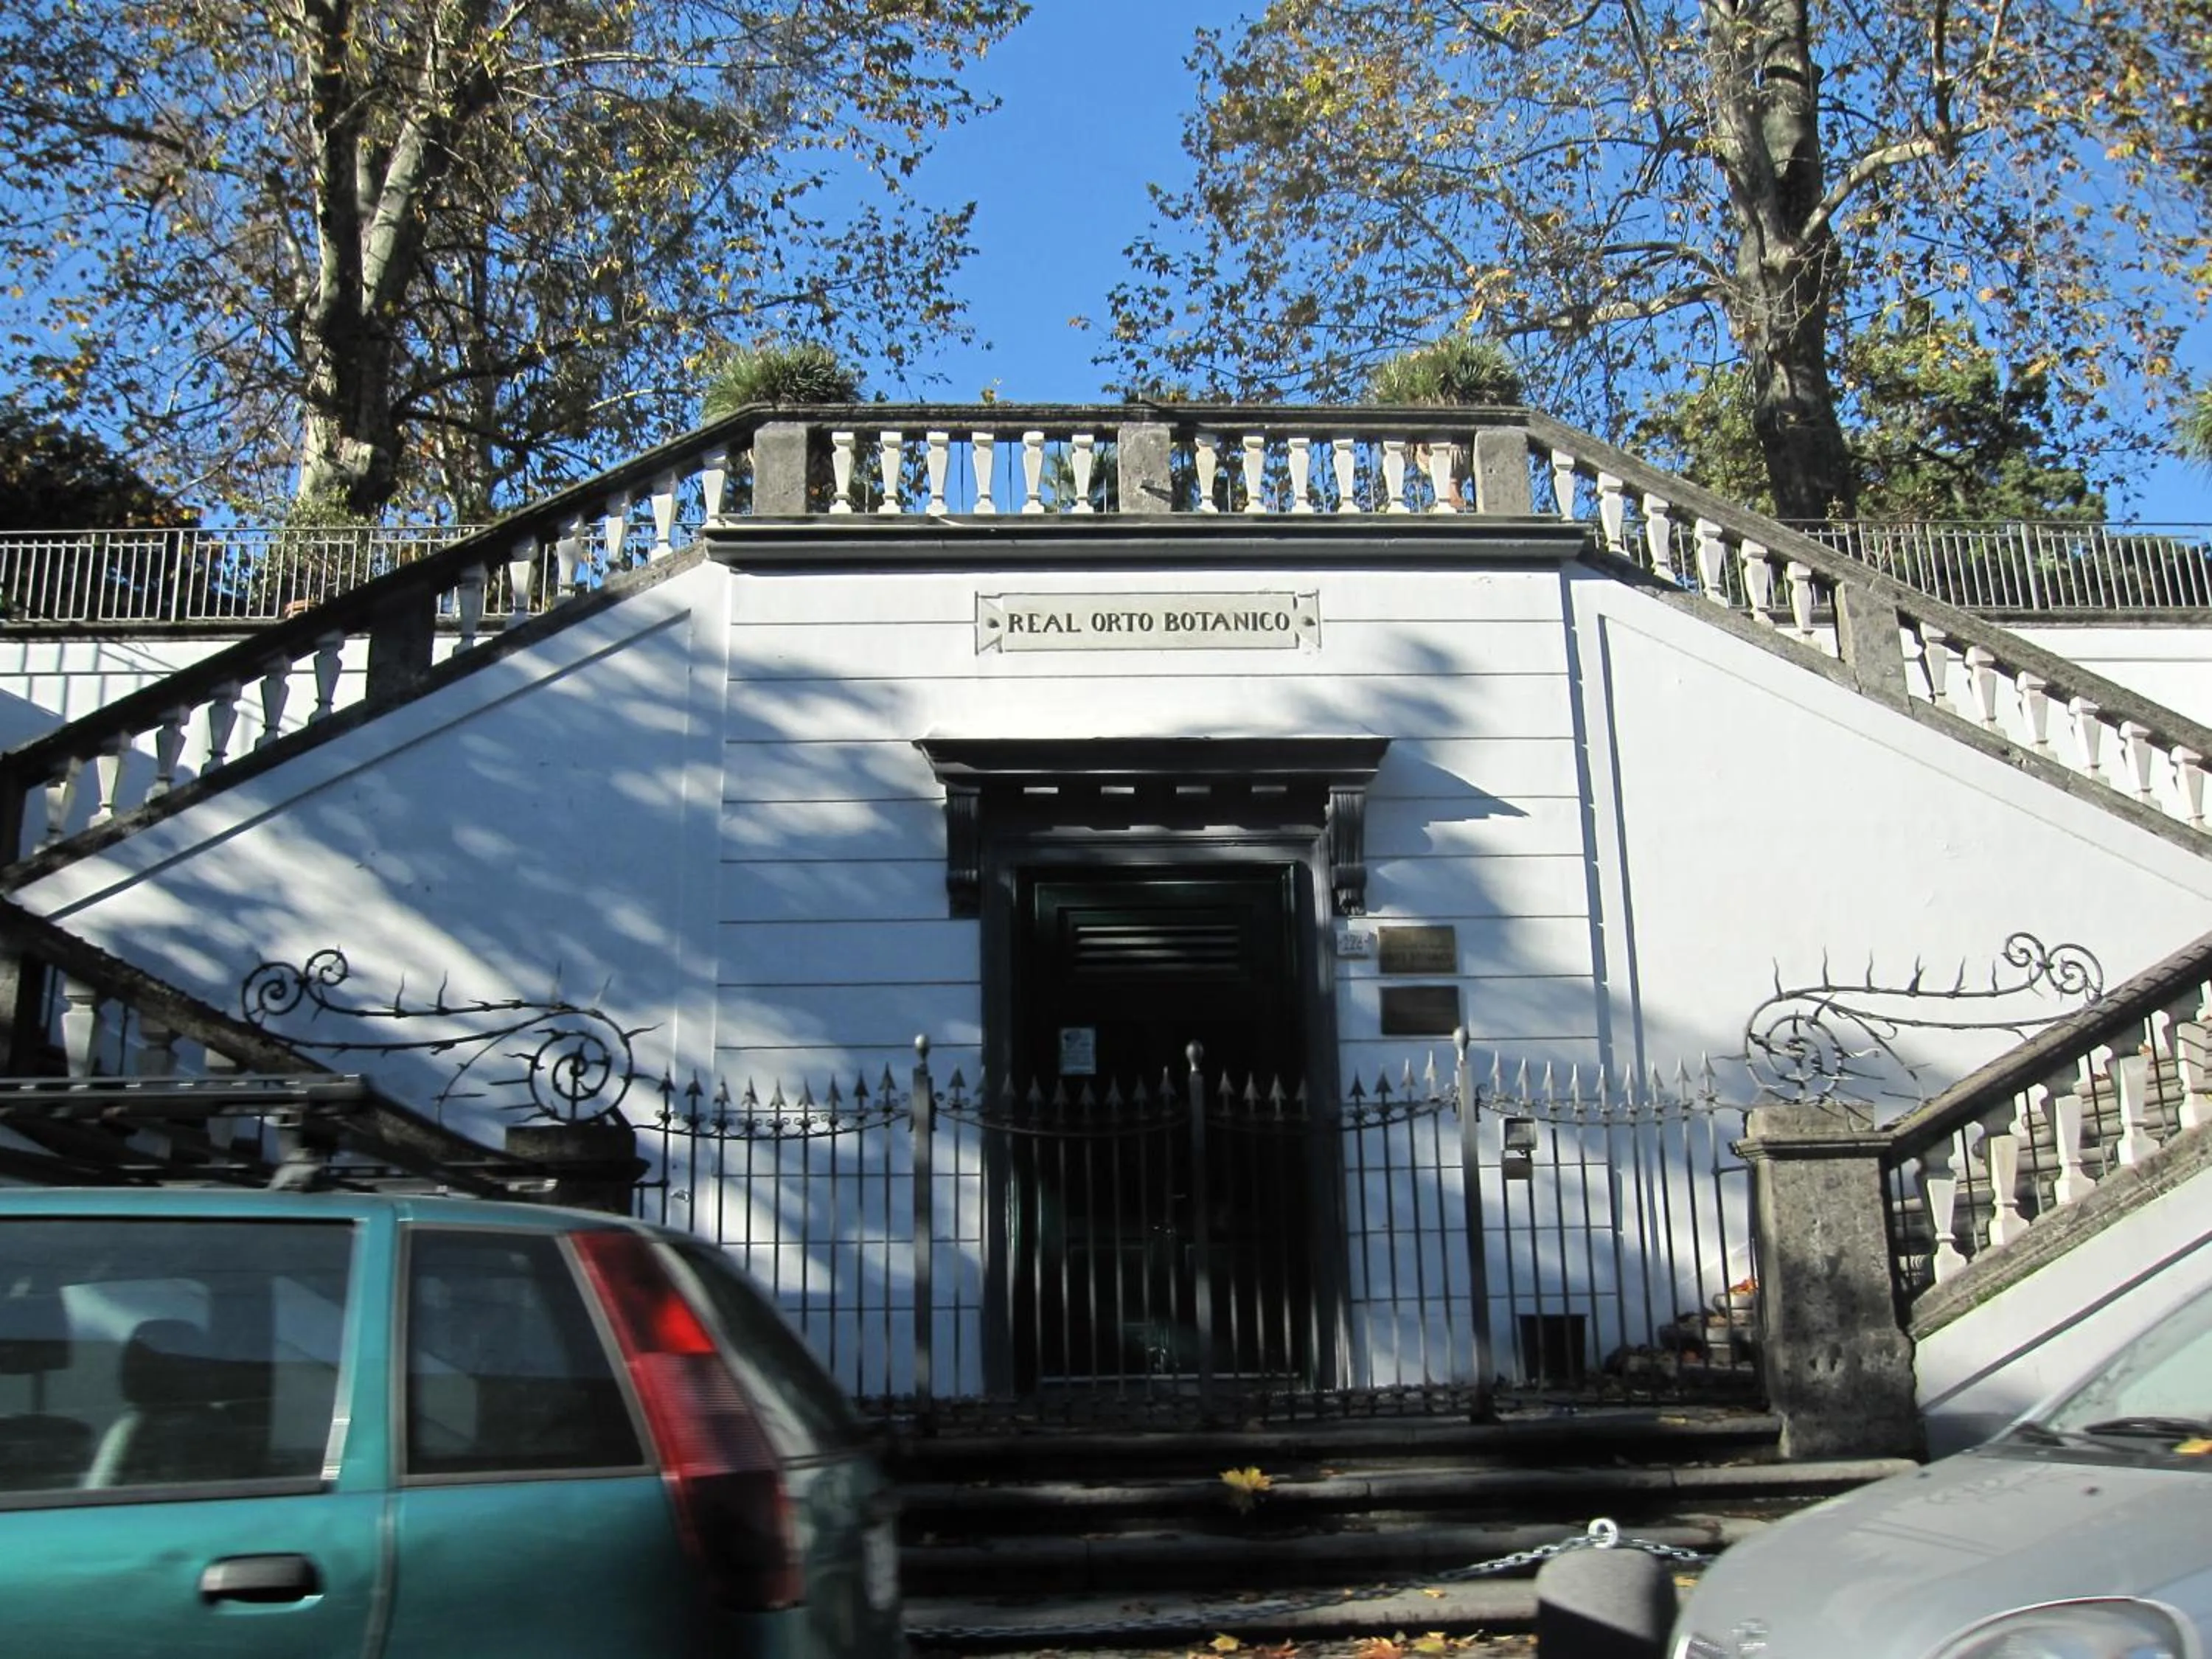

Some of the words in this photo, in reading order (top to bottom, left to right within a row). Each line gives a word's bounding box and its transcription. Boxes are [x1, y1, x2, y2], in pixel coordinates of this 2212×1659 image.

[1008, 613, 1082, 633] REAL
[1091, 612, 1154, 632] ORTO
[1164, 611, 1290, 632] BOTANICO
